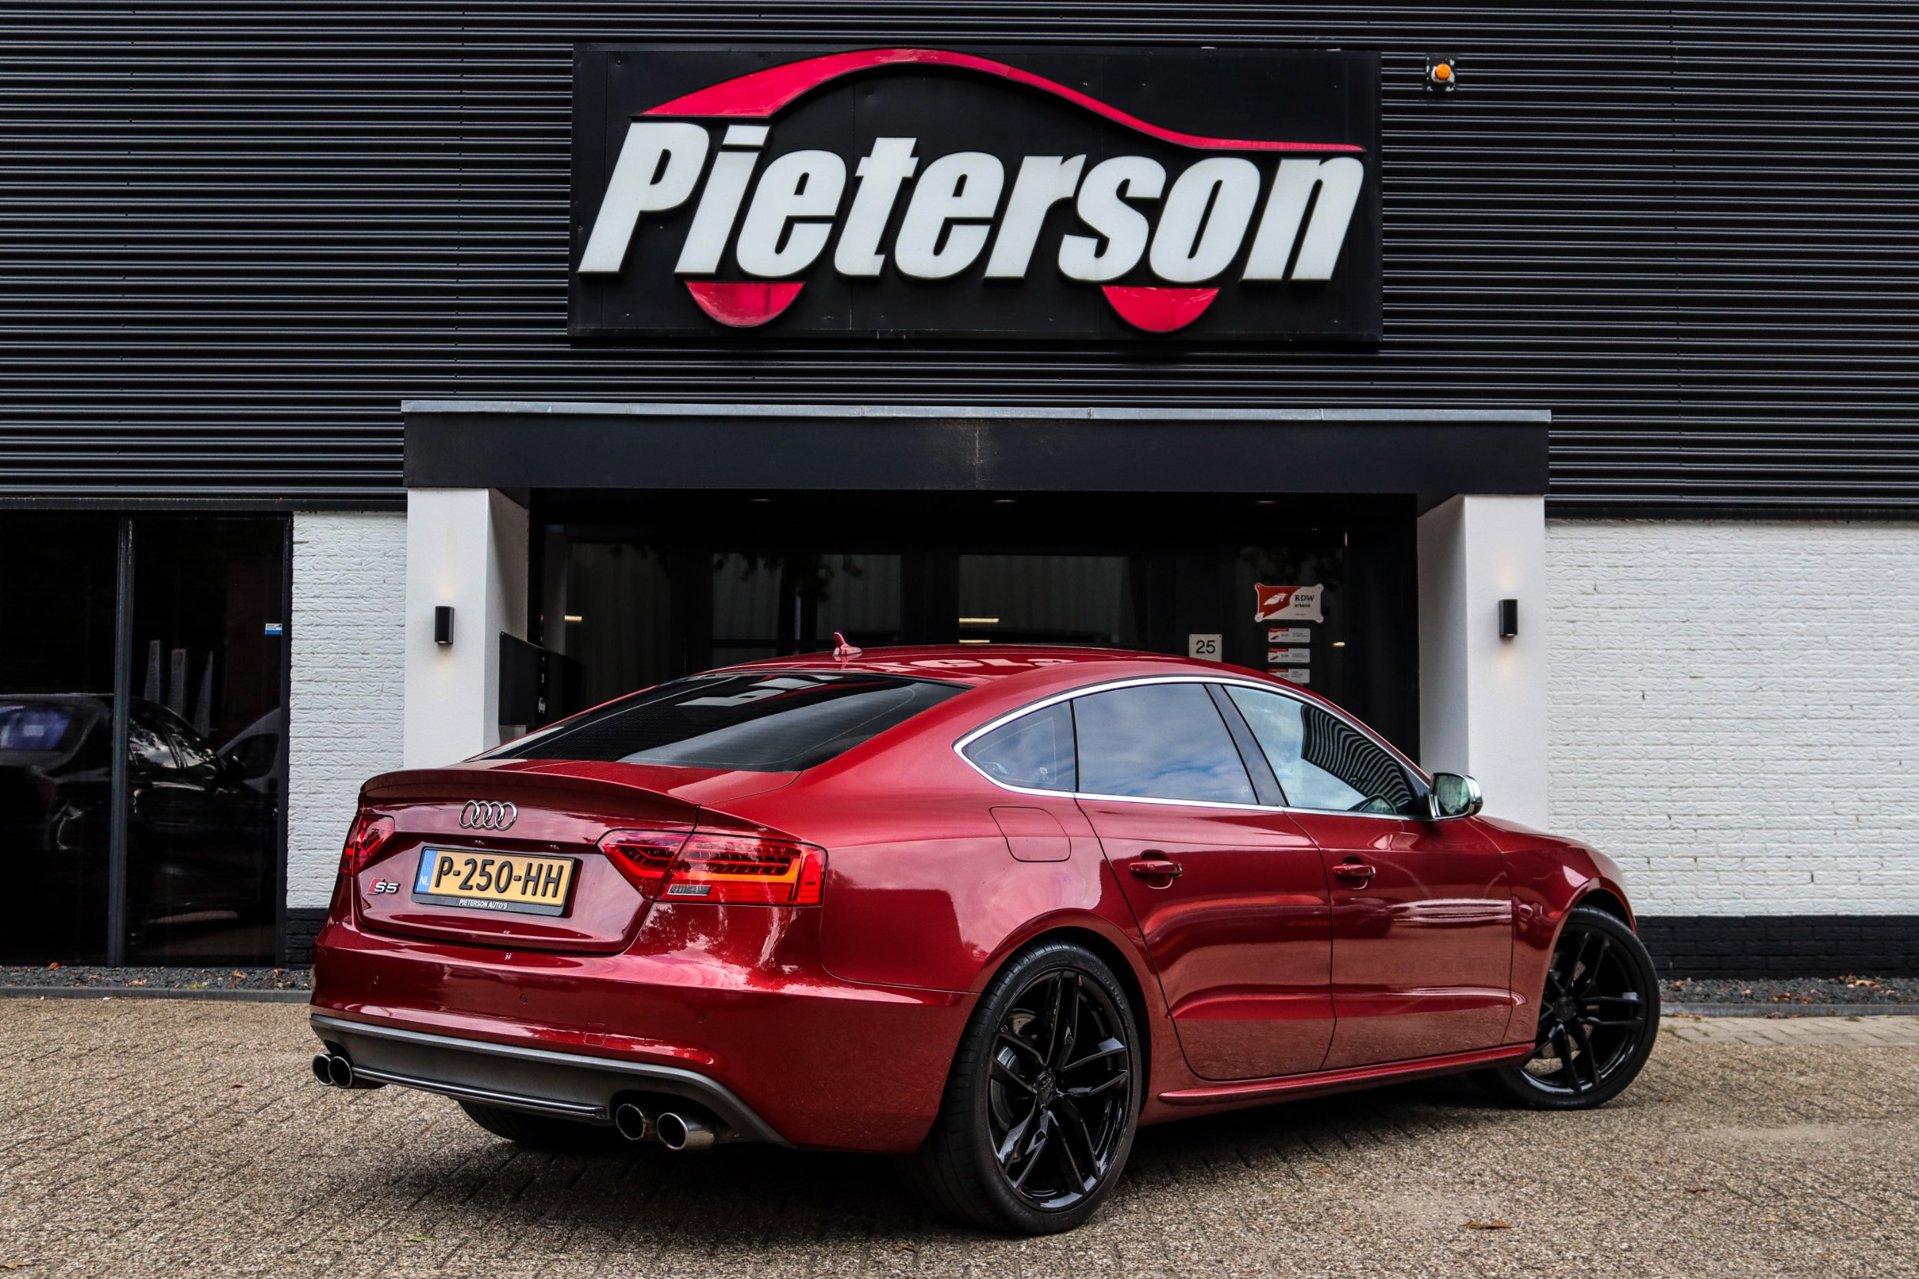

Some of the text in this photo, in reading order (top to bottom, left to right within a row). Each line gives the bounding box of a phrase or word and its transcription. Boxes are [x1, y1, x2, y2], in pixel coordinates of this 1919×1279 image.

[577, 121, 1366, 282] Pieterson
[1195, 640, 1216, 653] 25
[419, 875, 430, 886] NL
[434, 855, 564, 898] P-250-HH
[374, 881, 399, 895] S5
[458, 898, 489, 908] PIETERSON
